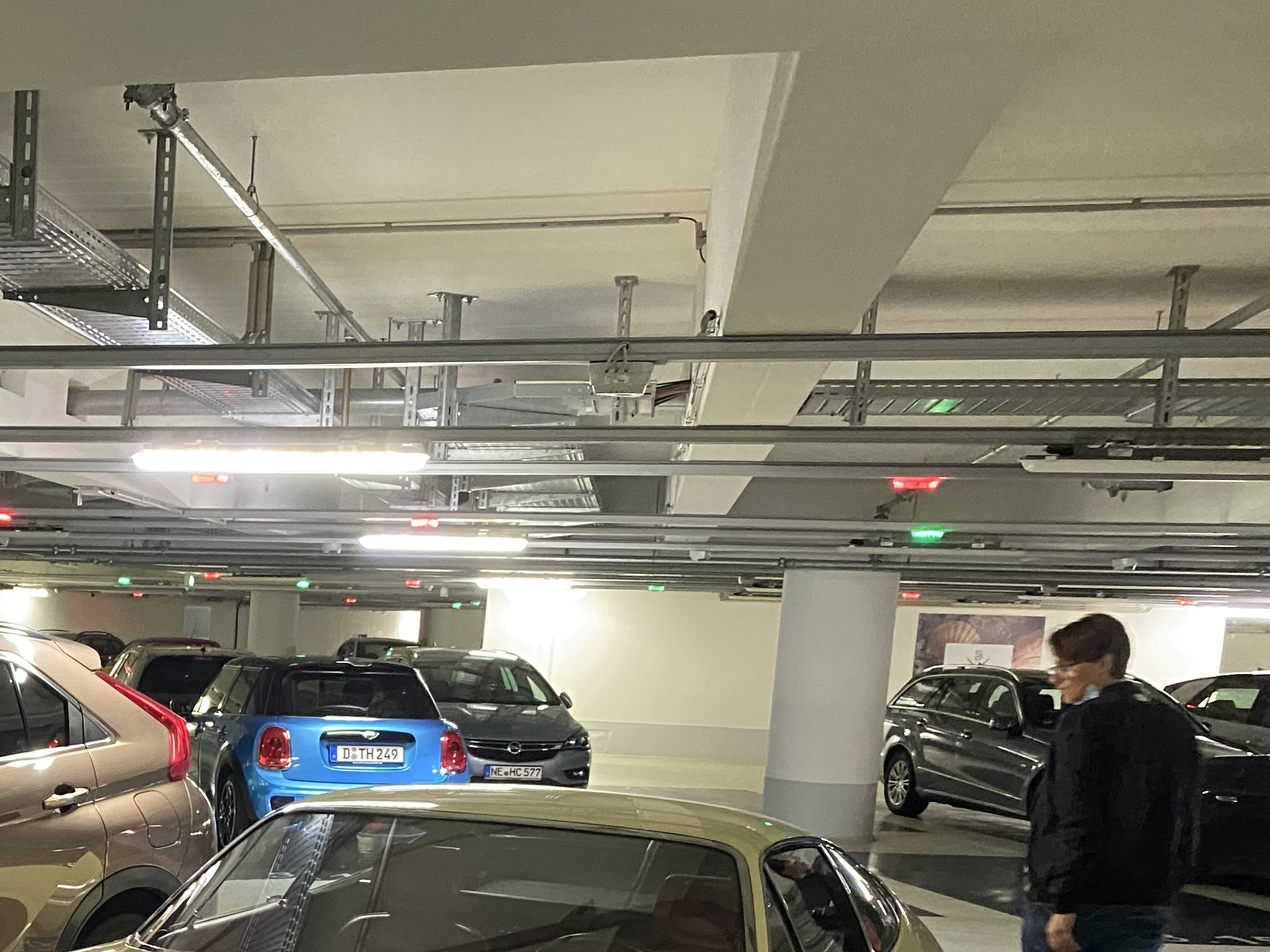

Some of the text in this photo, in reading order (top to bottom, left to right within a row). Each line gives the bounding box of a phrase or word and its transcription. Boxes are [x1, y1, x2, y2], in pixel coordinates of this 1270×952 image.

[358, 747, 375, 760] TH
[376, 748, 399, 761] 249
[509, 767, 522, 777] HC
[523, 767, 542, 778] 577
